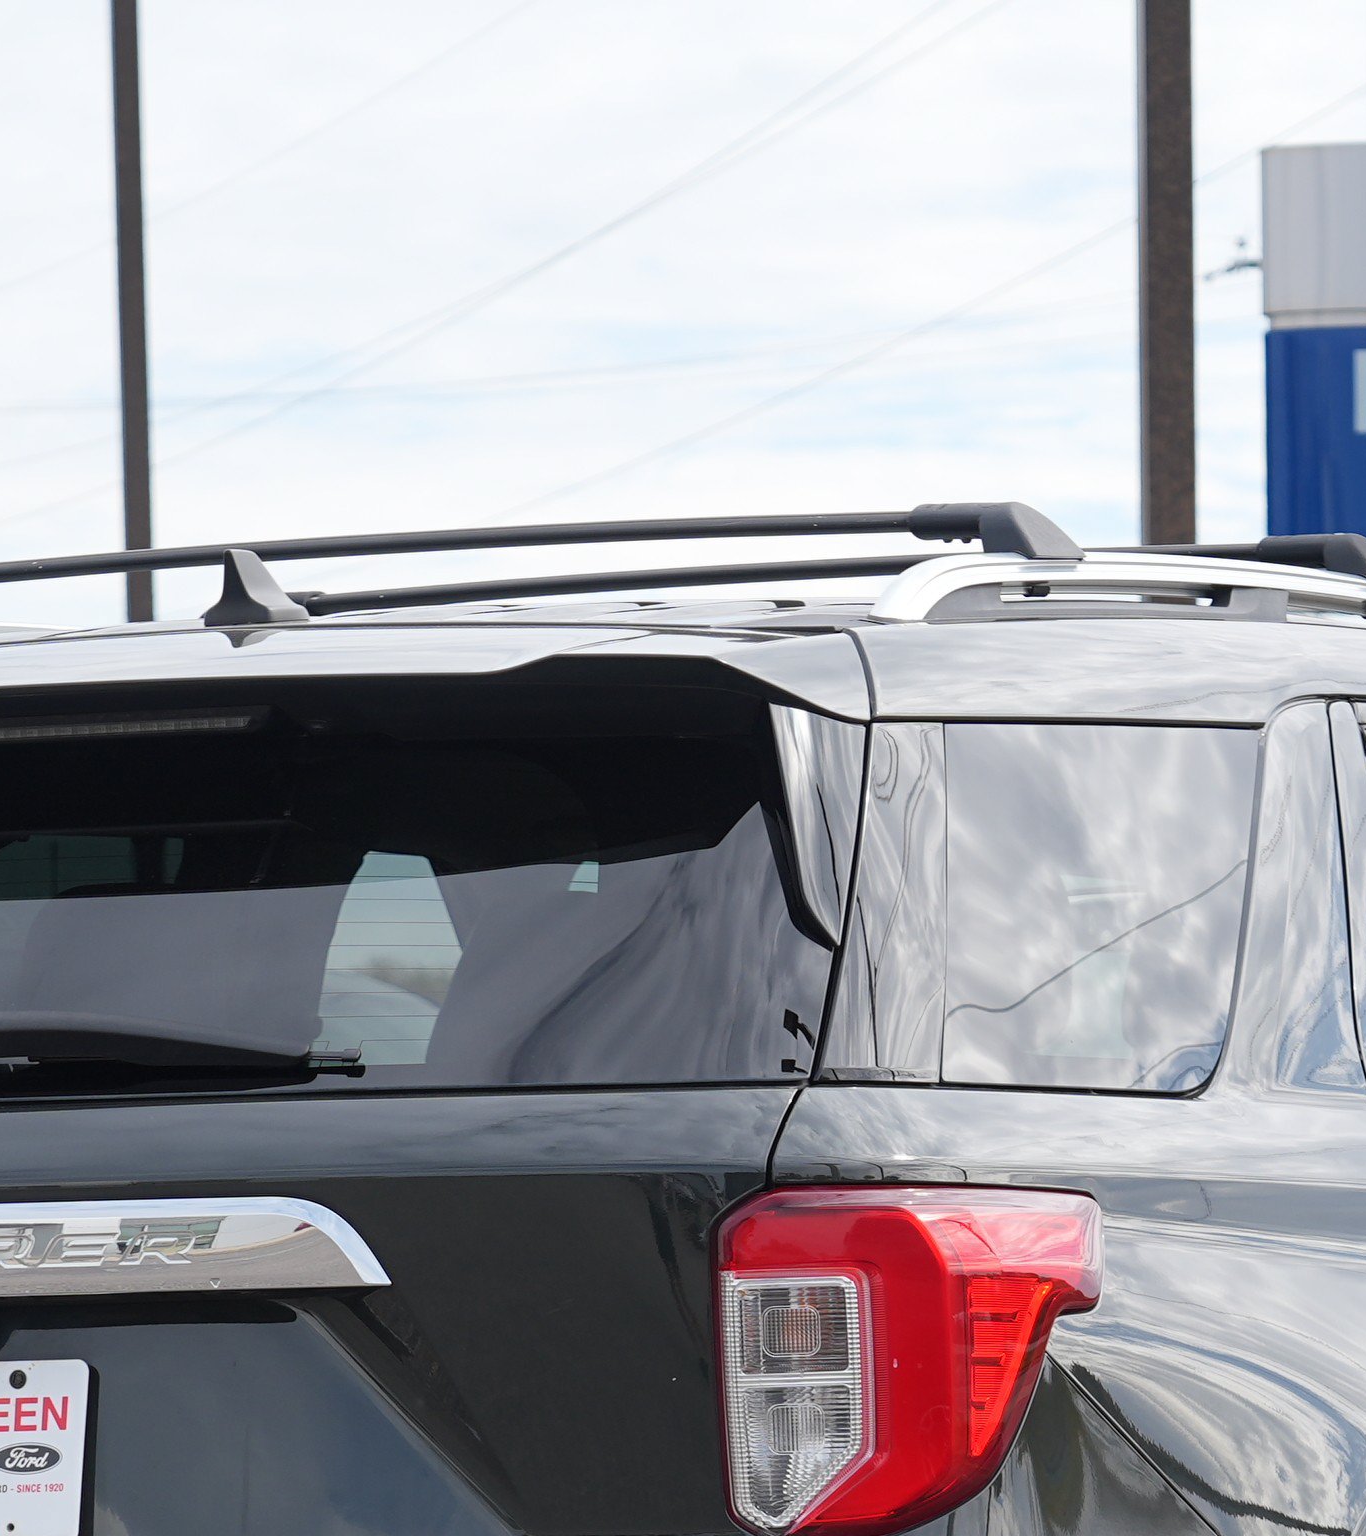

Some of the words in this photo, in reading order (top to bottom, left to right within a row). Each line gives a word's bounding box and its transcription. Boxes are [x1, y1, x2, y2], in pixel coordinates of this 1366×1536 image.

[5, 1446, 48, 1470] Ford
[16, 1483, 42, 1493] SINCE
[44, 1482, 65, 1493] 1920
